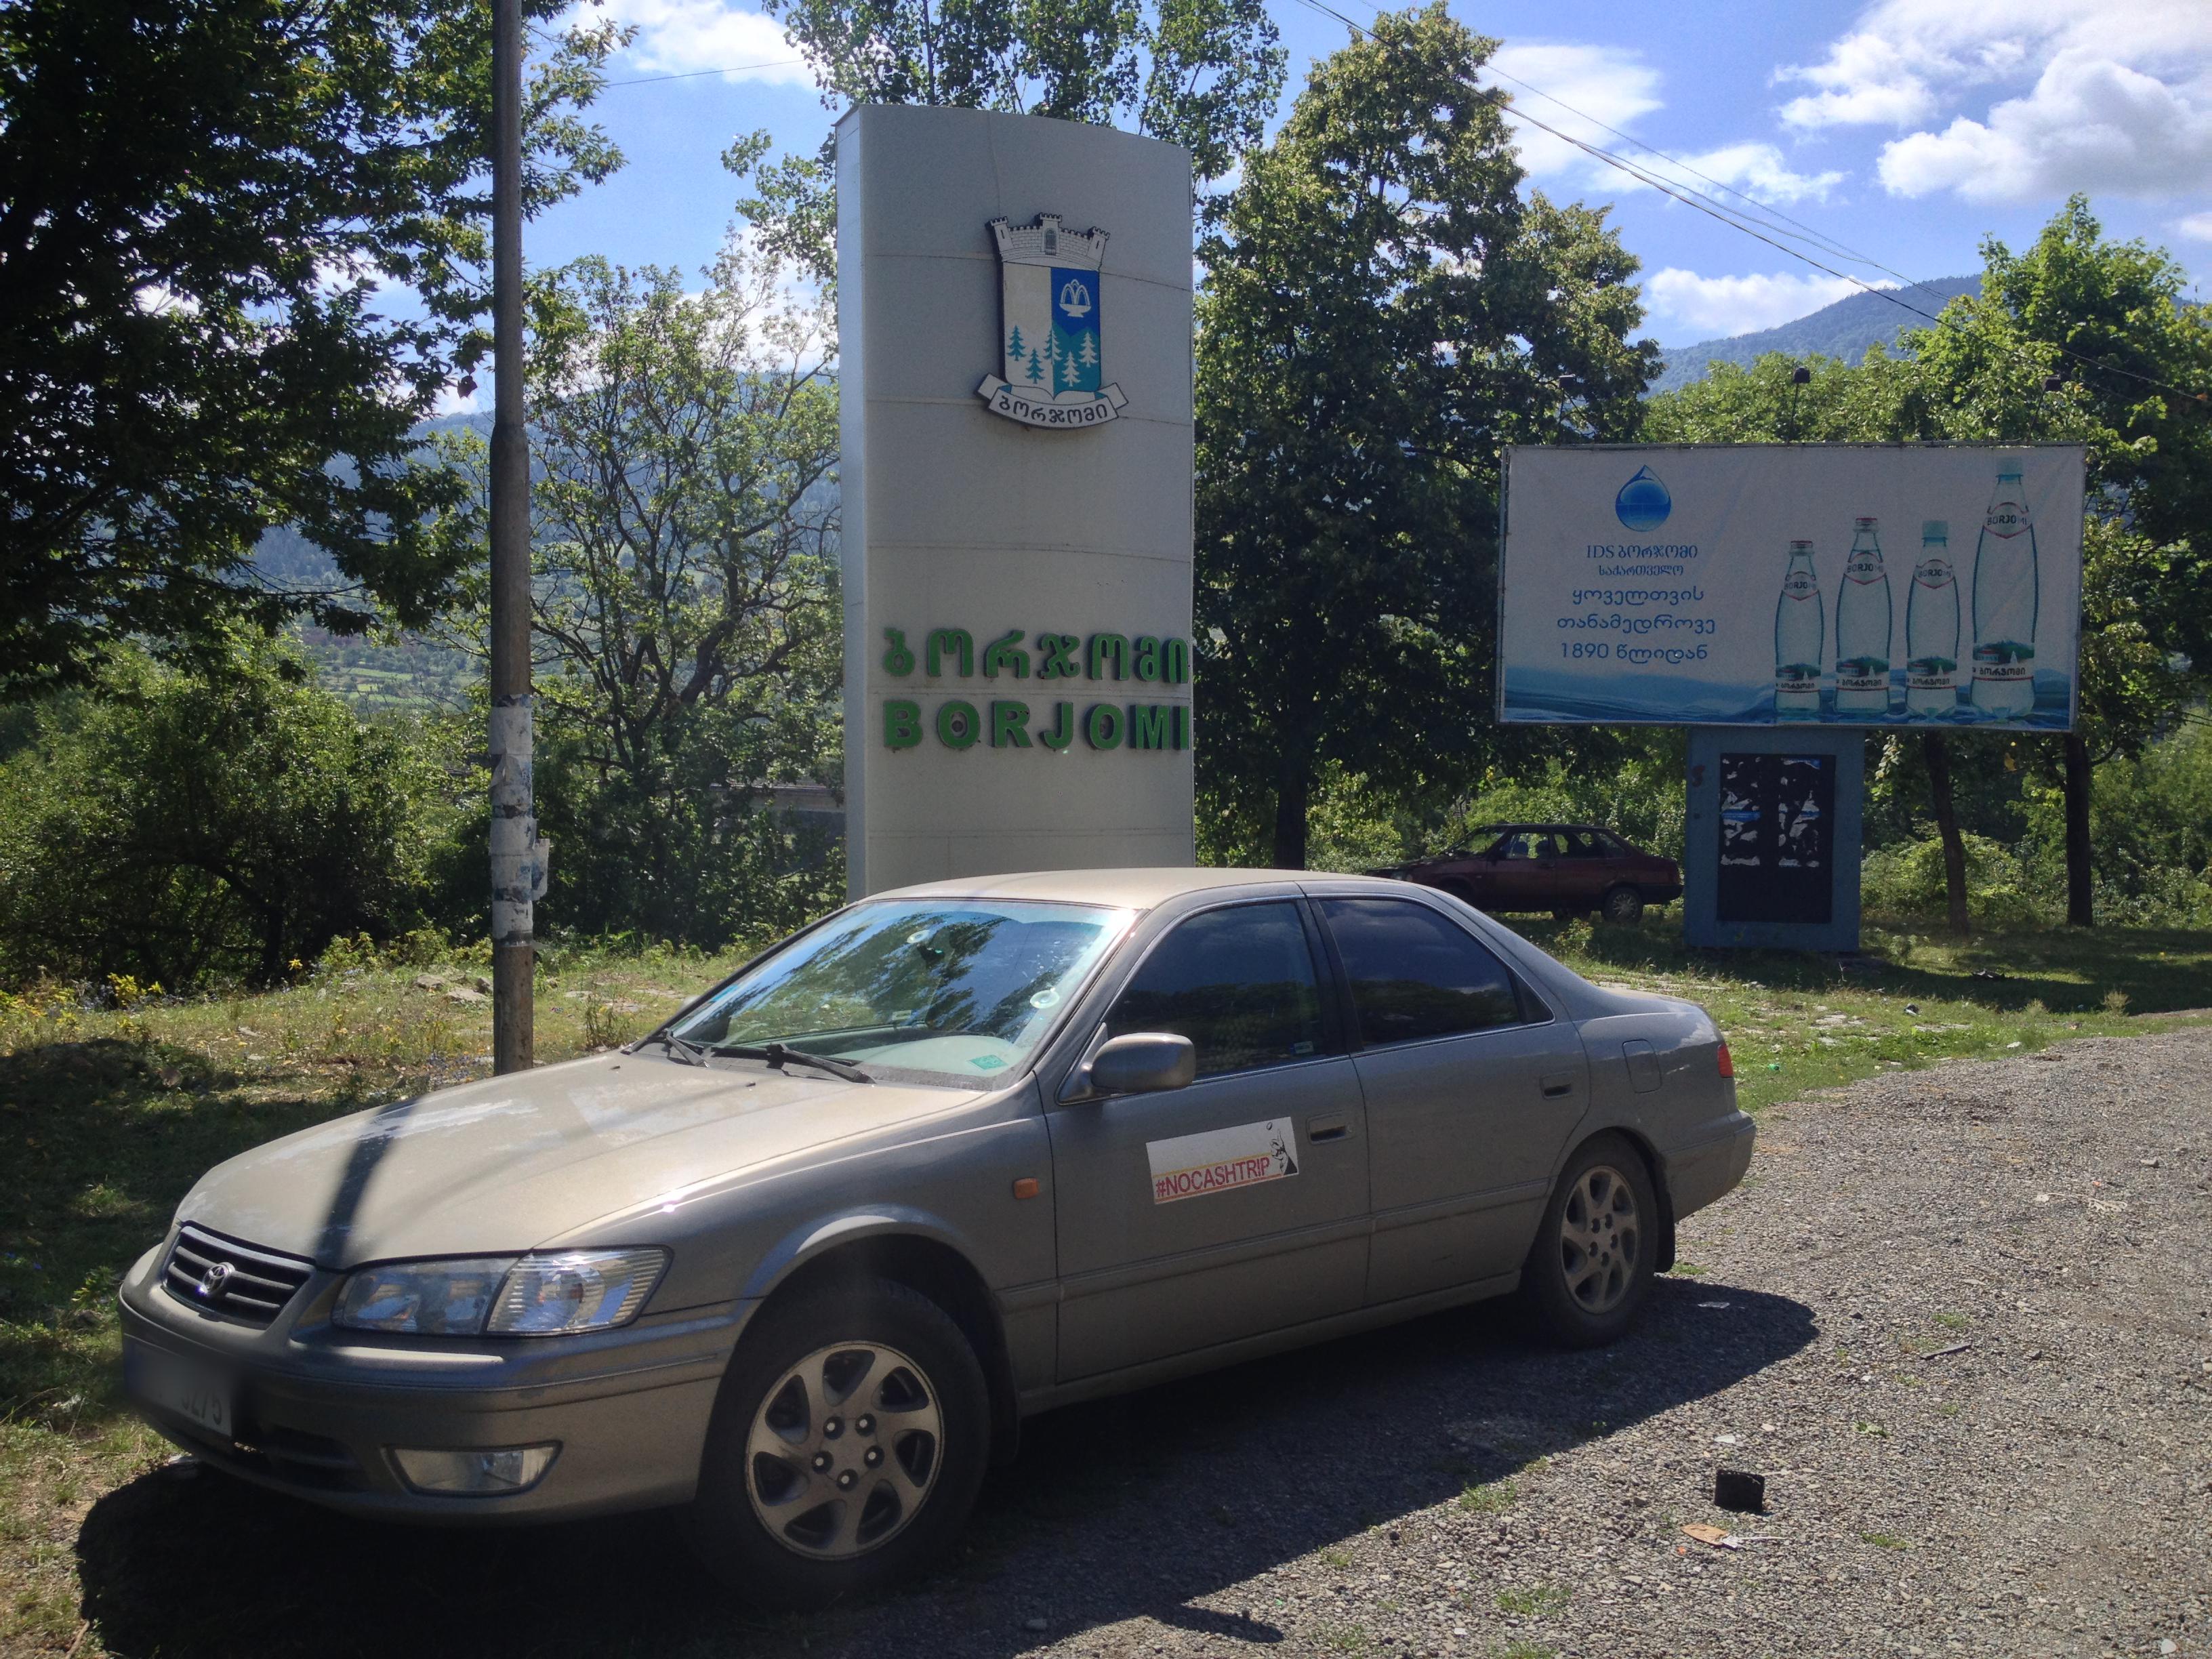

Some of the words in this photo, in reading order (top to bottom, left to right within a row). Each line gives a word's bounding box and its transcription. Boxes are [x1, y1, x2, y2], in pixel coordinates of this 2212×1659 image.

[998, 394, 1107, 424] ბორჯომი
[1586, 545, 1615, 559] IDS
[1618, 544, 1698, 559] ბორჯომი
[1599, 565, 1684, 576] საქართველო
[1572, 585, 1704, 606] ყოველთვის
[1557, 613, 1715, 634] თანამედროვე
[882, 626, 1189, 684] ბორჯომი
[1561, 642, 1610, 659] 1890
[1616, 644, 1708, 664] წლიდან
[882, 699, 1189, 751] BORJOMI
[1155, 1156, 1270, 1197] #NOCASHTRIP
